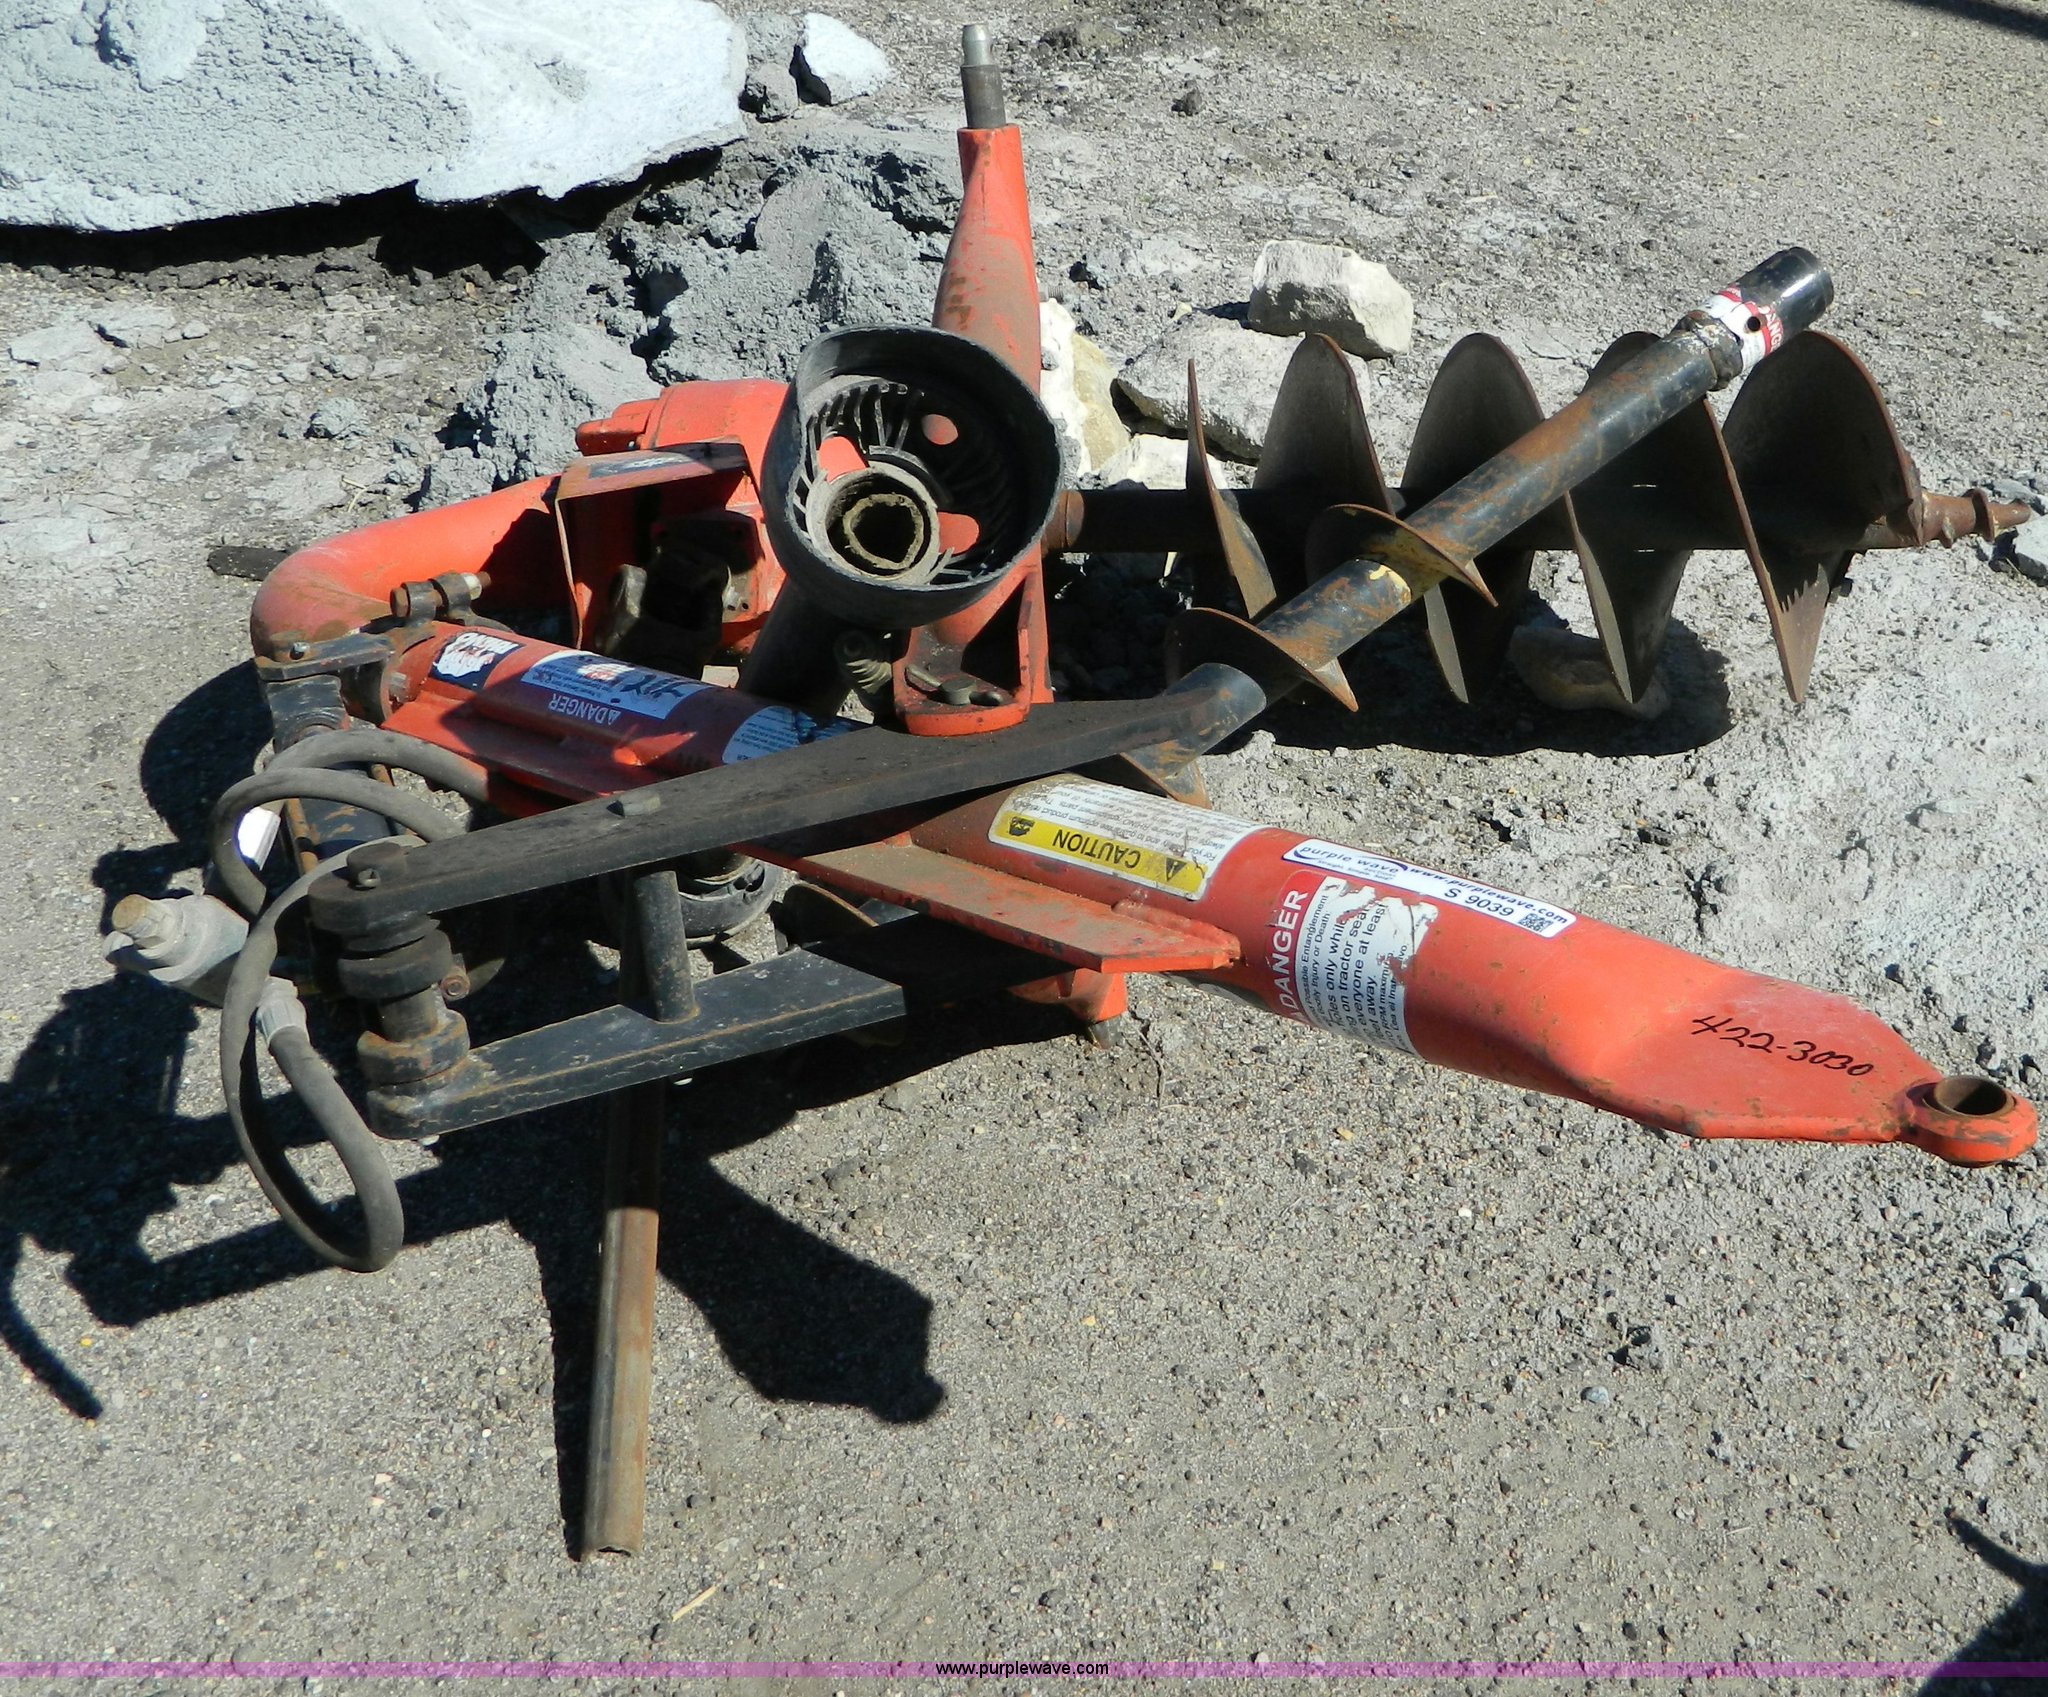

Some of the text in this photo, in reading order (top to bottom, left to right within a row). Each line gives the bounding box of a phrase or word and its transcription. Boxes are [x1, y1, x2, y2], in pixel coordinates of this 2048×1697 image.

[548, 693, 608, 723] DANGER
[1041, 807, 1068, 818] product
[1051, 829, 1140, 869] CAUTION
[1300, 845, 1398, 874] purple wave
[1409, 866, 1569, 925] www.purplewave.com
[1444, 886, 1513, 918] S 9039
[1271, 889, 1308, 1010] DANGER
[1301, 894, 1328, 1004] Possible Entanglement
[1314, 945, 1319, 956] or
[1358, 941, 1369, 954] at
[1311, 958, 1319, 987] Injury
[1324, 958, 1337, 990] only
[1338, 940, 1353, 990] tractor
[1341, 995, 1349, 1011] on
[1351, 959, 1366, 1025] everyone
[1366, 975, 1377, 1016] away.
[1379, 1006, 1389, 1029] RPM
[1691, 1014, 1875, 1077] 422-3030
